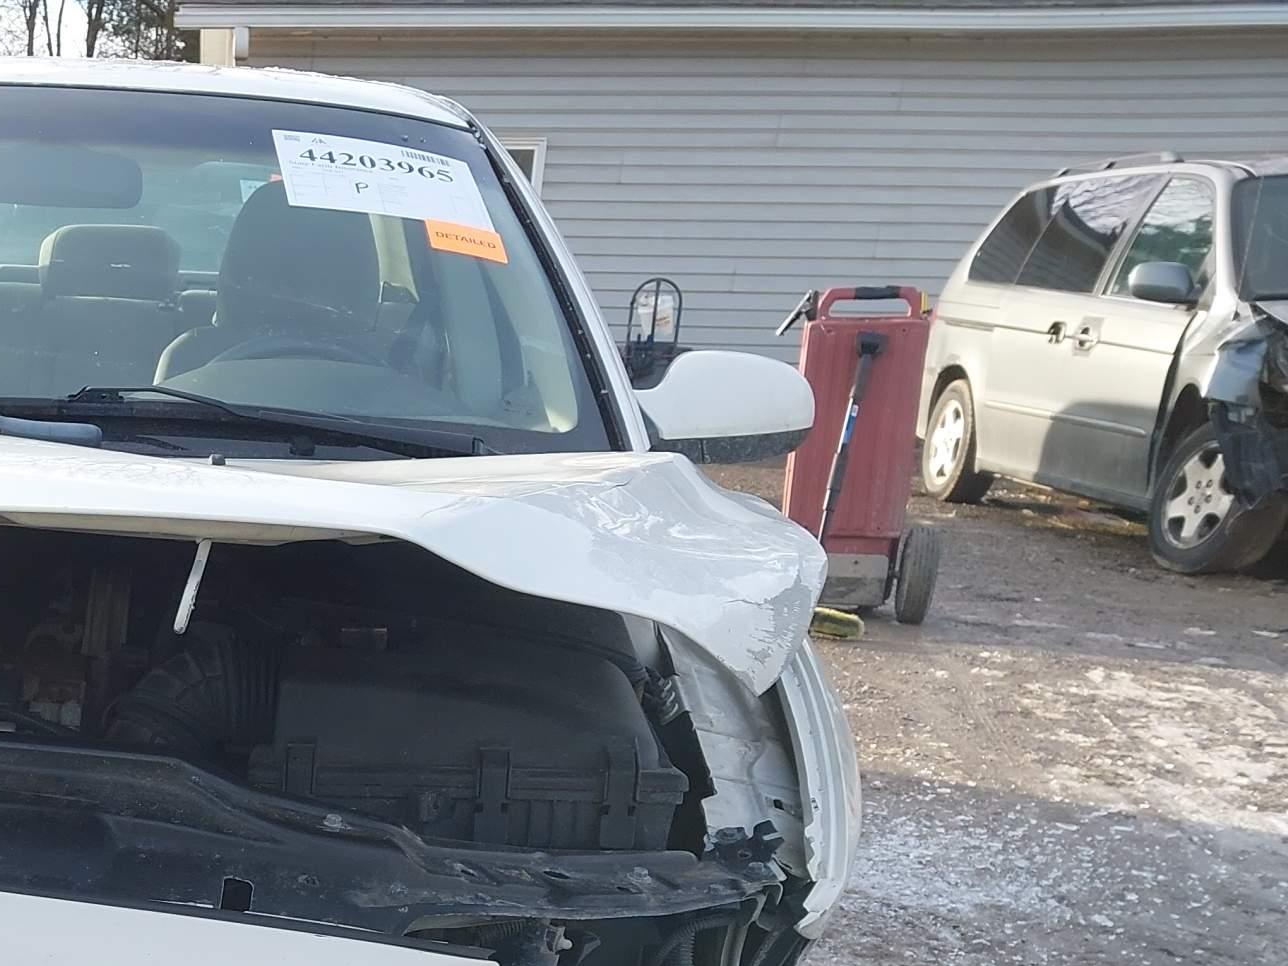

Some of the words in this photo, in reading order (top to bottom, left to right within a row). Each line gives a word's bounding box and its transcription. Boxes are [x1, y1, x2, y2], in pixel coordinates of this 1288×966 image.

[299, 148, 454, 183] 44203965
[354, 182, 369, 194] P
[435, 231, 496, 249] DETAILED
